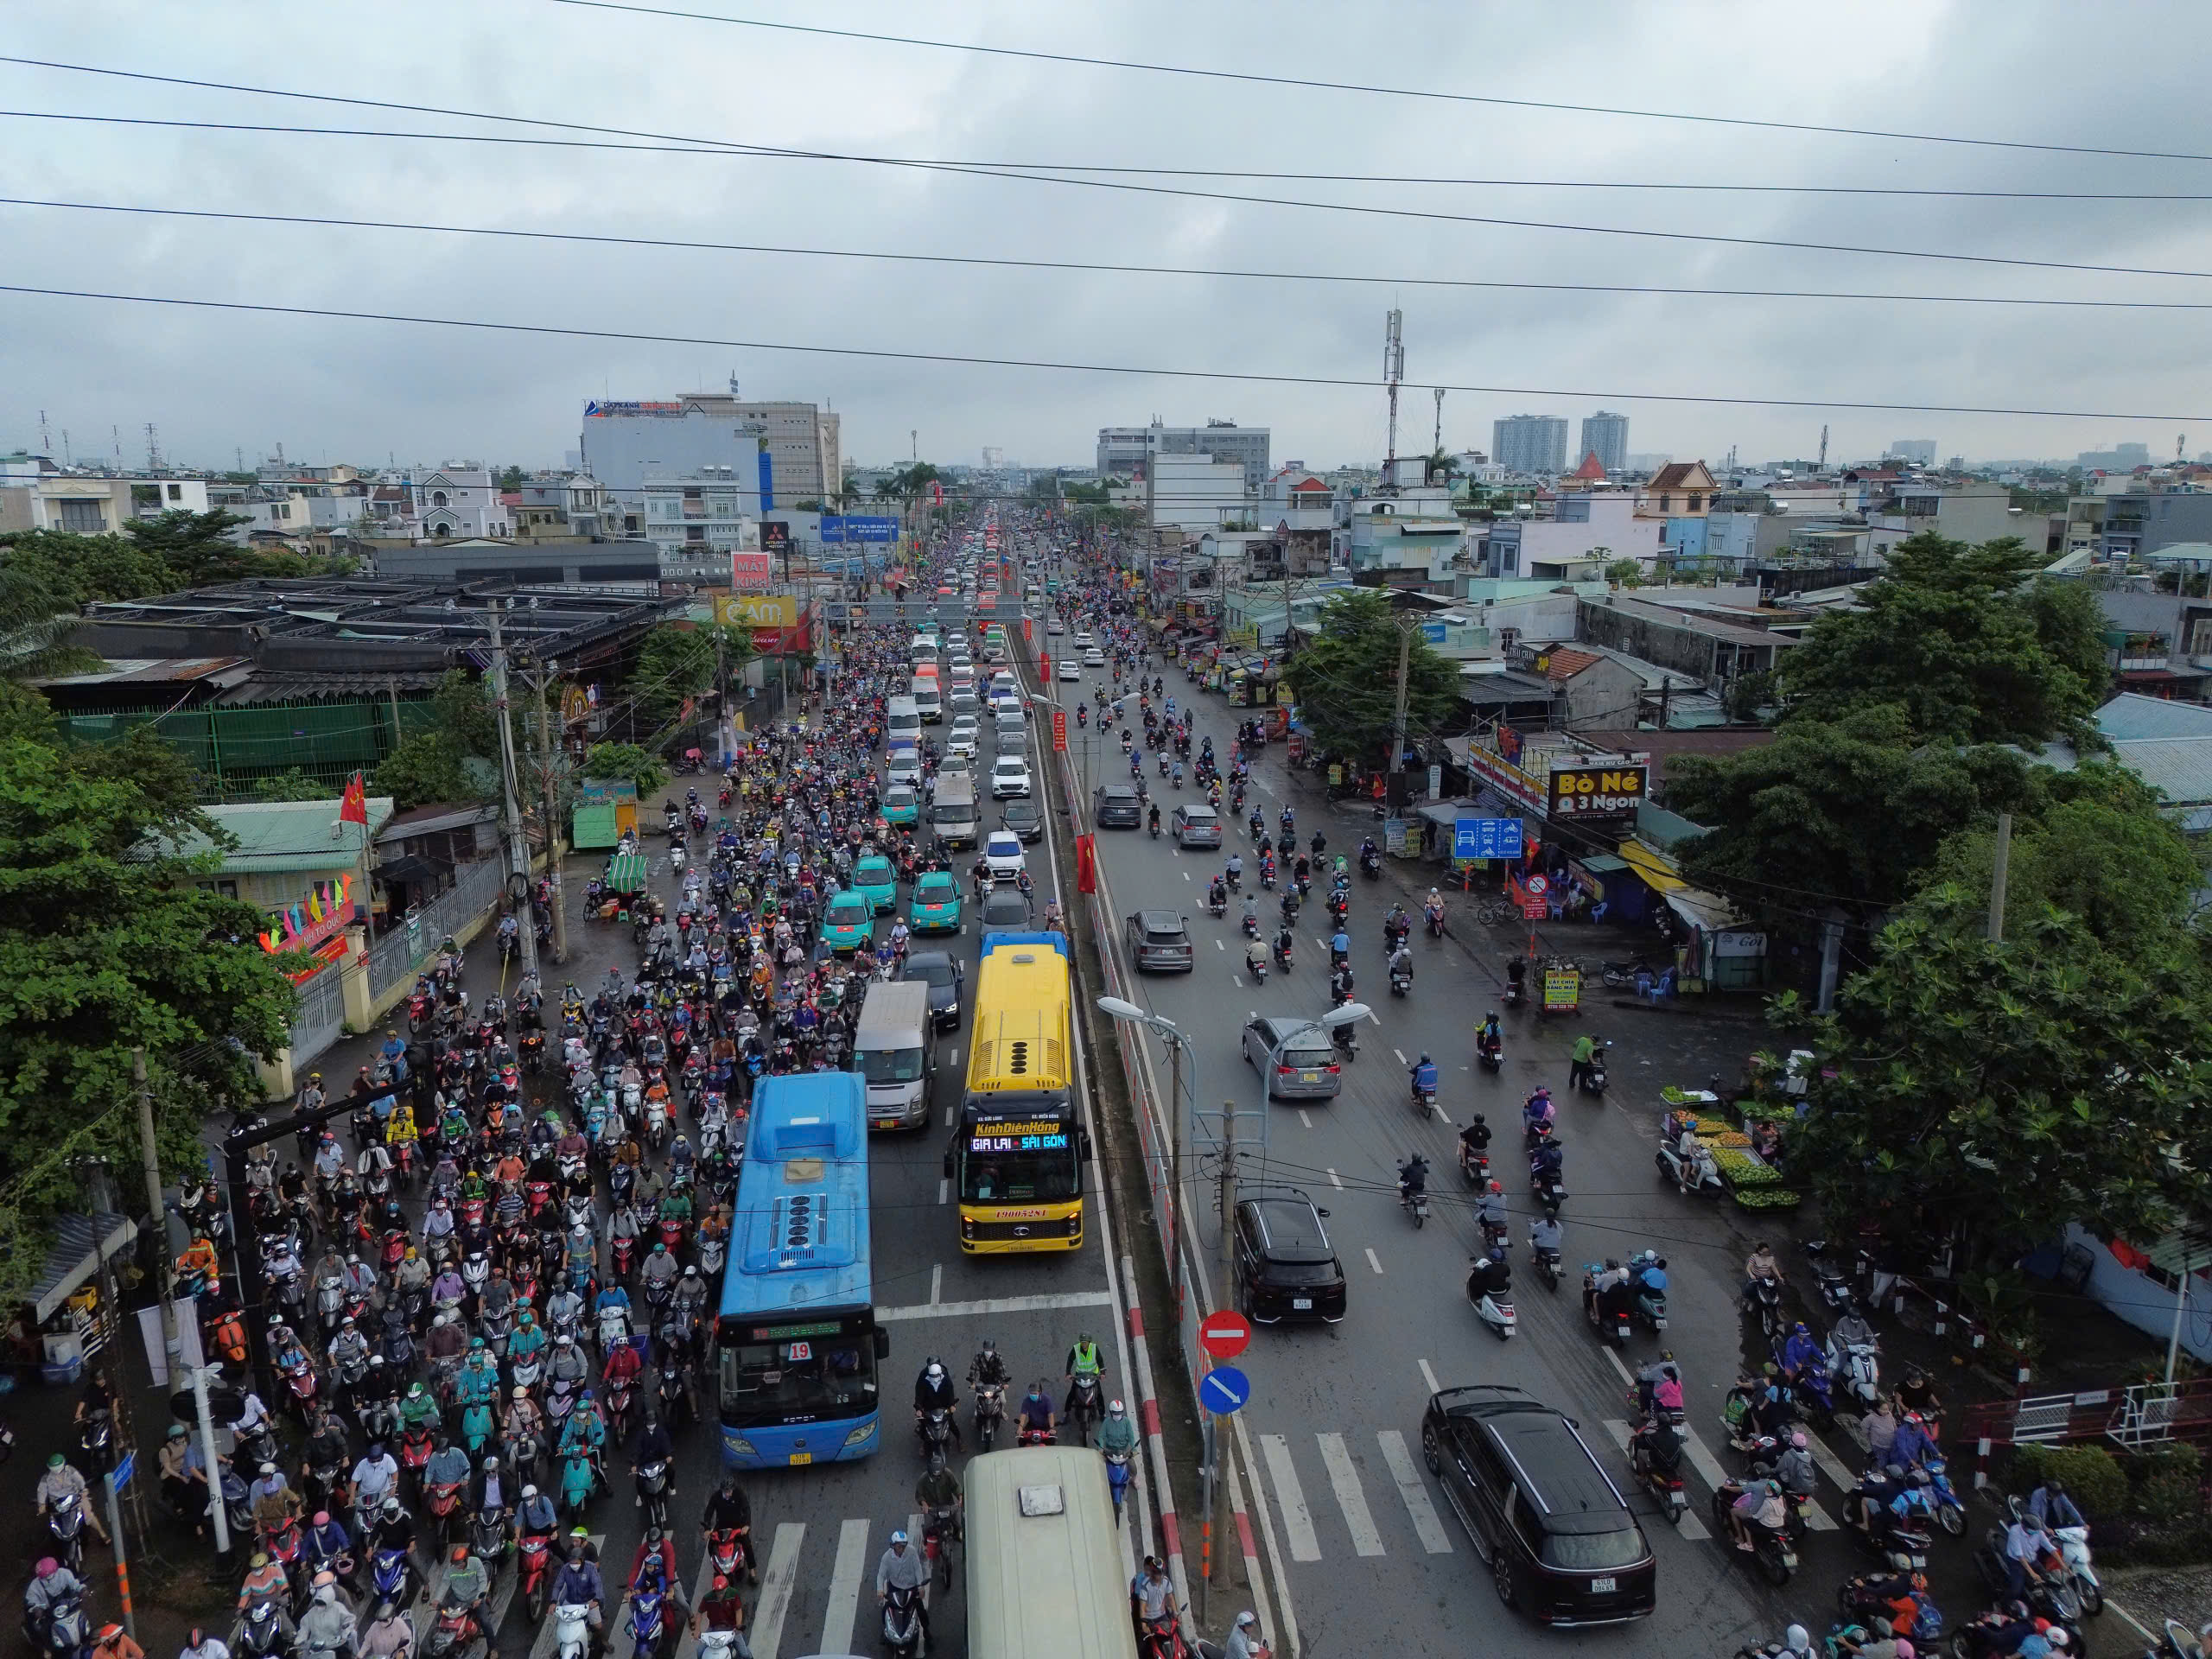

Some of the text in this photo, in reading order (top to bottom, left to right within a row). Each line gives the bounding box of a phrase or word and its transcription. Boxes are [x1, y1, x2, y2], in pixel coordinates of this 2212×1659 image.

[736, 573, 767, 588] KÍNH
[1558, 773, 1595, 794] Bò
[1601, 771, 1639, 792] Né
[1578, 794, 1640, 811] 3 Ngon
[972, 1133, 1065, 1150] GIA LAI SÀI GÒN
[995, 1209, 1046, 1218] 19005281
[791, 1344, 809, 1358] 19
